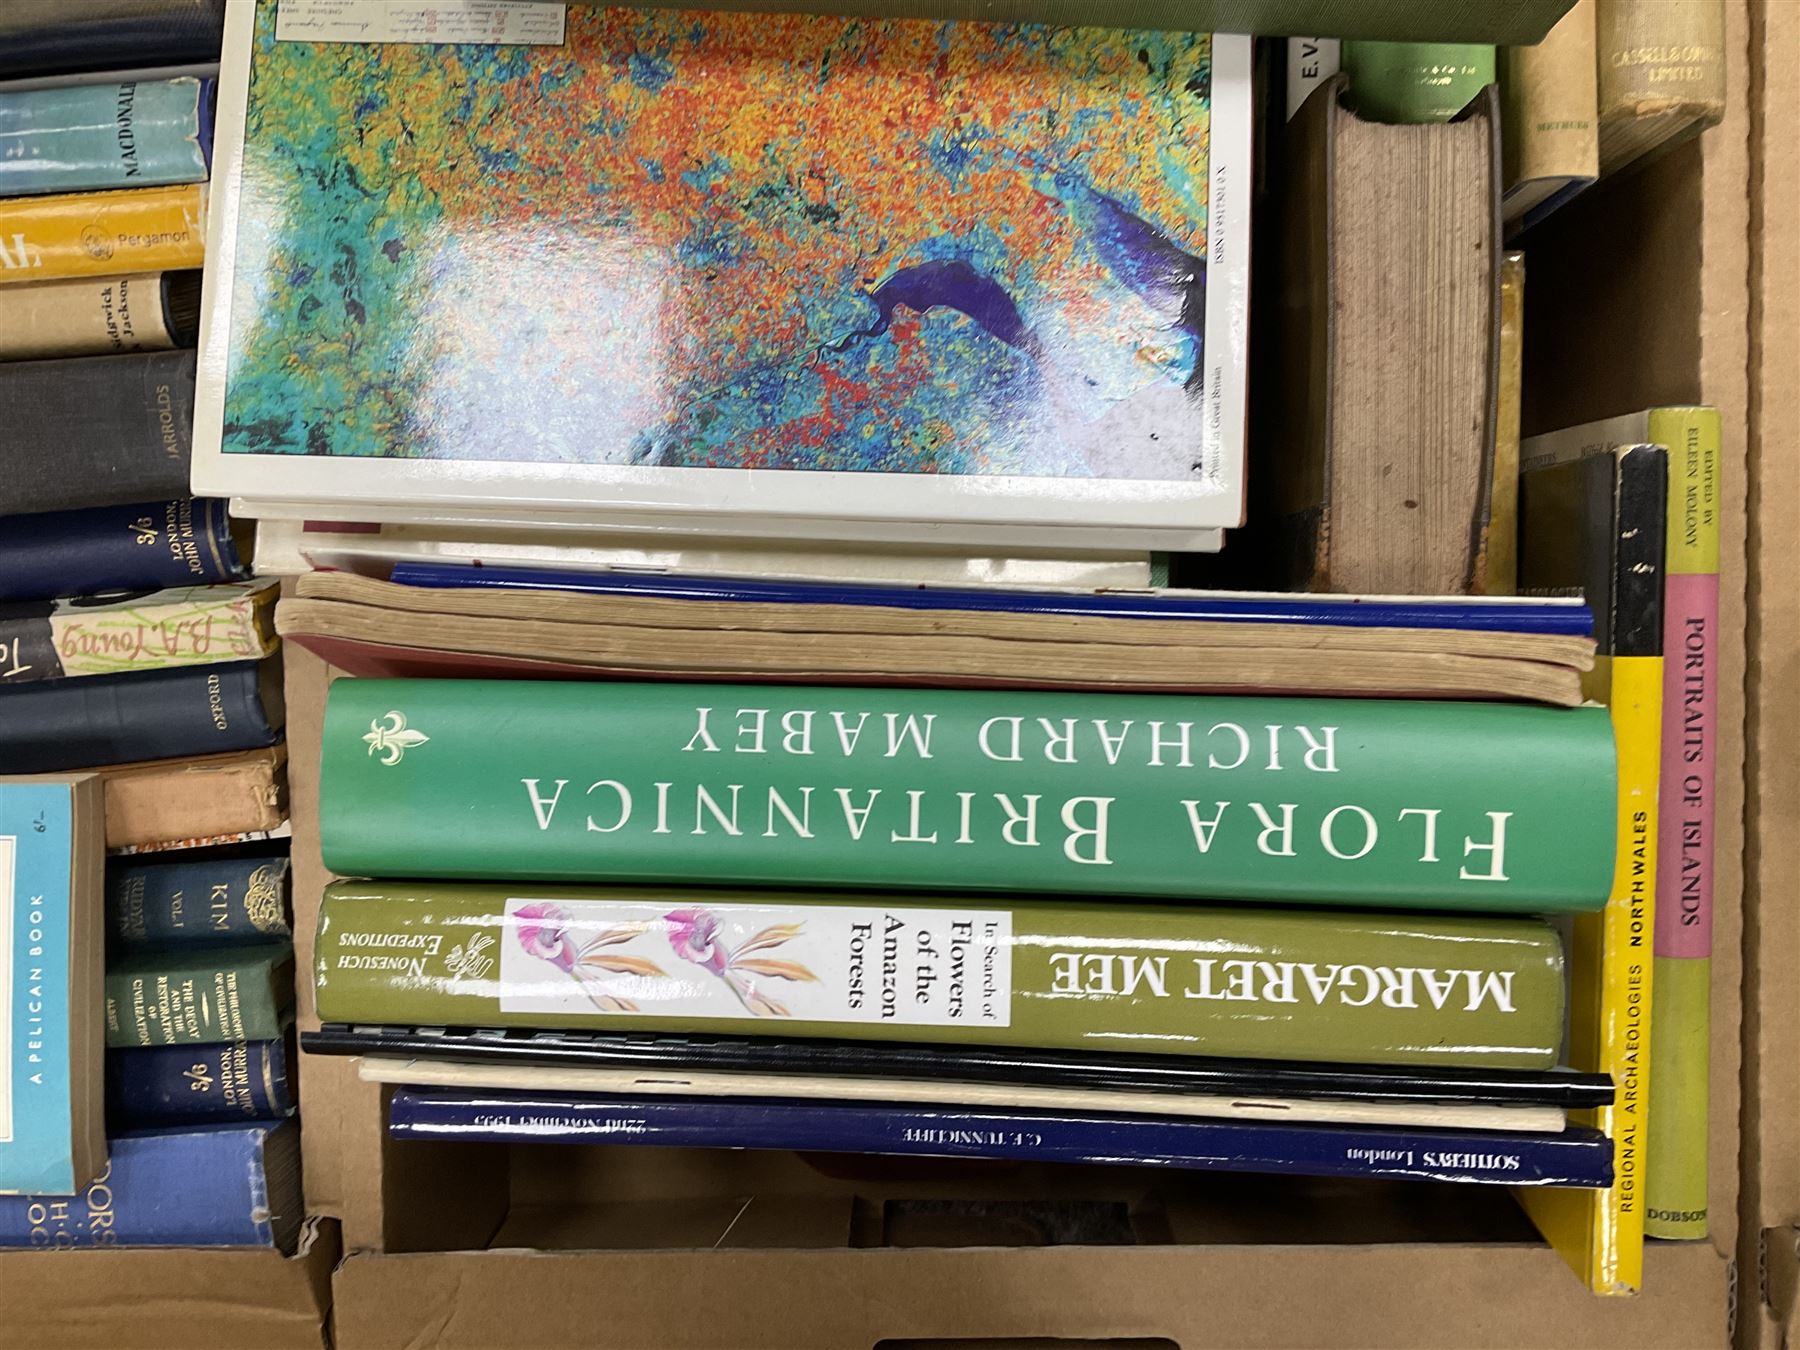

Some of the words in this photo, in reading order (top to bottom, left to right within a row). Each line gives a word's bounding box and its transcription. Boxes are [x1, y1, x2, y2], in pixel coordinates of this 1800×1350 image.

[116, 81, 141, 178] MACDONALD
[118, 230, 190, 246] Pergamon
[1214, 238, 1224, 265] ISBN
[118, 279, 134, 337] Jackson
[1211, 365, 1222, 399] Britain
[156, 384, 182, 459] JARROLDS
[1211, 401, 1222, 429] Great
[1686, 427, 1700, 478] EILEEN
[1702, 450, 1714, 507] EDITED
[166, 501, 184, 561] LONDON,
[1684, 485, 1699, 548] MOLONY
[1702, 511, 1714, 527] BY
[184, 541, 204, 576] JOHN
[58, 623, 162, 661] Young
[207, 674, 228, 731] OXFORD
[1684, 617, 1705, 763] PORTRAITS
[680, 707, 938, 759] MABEY
[978, 716, 1340, 773] RICHARD
[1683, 776, 1704, 807] OF
[520, 778, 1115, 866] BRITANNICA
[1181, 799, 1514, 881] FLORA
[1632, 810, 1647, 876] WALES
[1680, 821, 1703, 927] ISLANDS
[30, 895, 43, 952] BOOK
[211, 883, 231, 931] KIM
[985, 921, 999, 938] In
[1629, 881, 1645, 947] NORTH
[338, 956, 427, 978] NONESUCH
[339, 932, 443, 956] EXPEDITIONS
[848, 922, 872, 1009] Forests
[881, 913, 906, 1019] Amazon
[916, 930, 939, 958] of
[182, 979, 193, 1003] THE
[915, 965, 937, 1004] the
[949, 920, 973, 1018] Flowers
[983, 945, 998, 999] Search
[1050, 953, 1169, 998] MEE
[1185, 957, 1517, 1014] MARGARET
[29, 968, 42, 1062] PELICAN
[132, 979, 151, 1045] CIVILIZATION
[148, 1005, 158, 1019] OF
[157, 975, 176, 1044] RESTORATION
[171, 990, 181, 1011] AND
[174, 1013, 185, 1033] THE
[184, 1005, 200, 1038] DECAY
[982, 1003, 997, 1019] of
[233, 1040, 249, 1085] MURRA
[1624, 964, 1642, 1113] ARCHAEOLOGIES
[30, 1072, 43, 1085] A
[901, 1127, 1007, 1146] TUNNICLIFFE
[1346, 1148, 1413, 1166] London
[1422, 1152, 1520, 1171] SOTHEBY'S
[1620, 1124, 1637, 1213] REGIONAL
[1647, 1207, 1707, 1223] DOBSON
